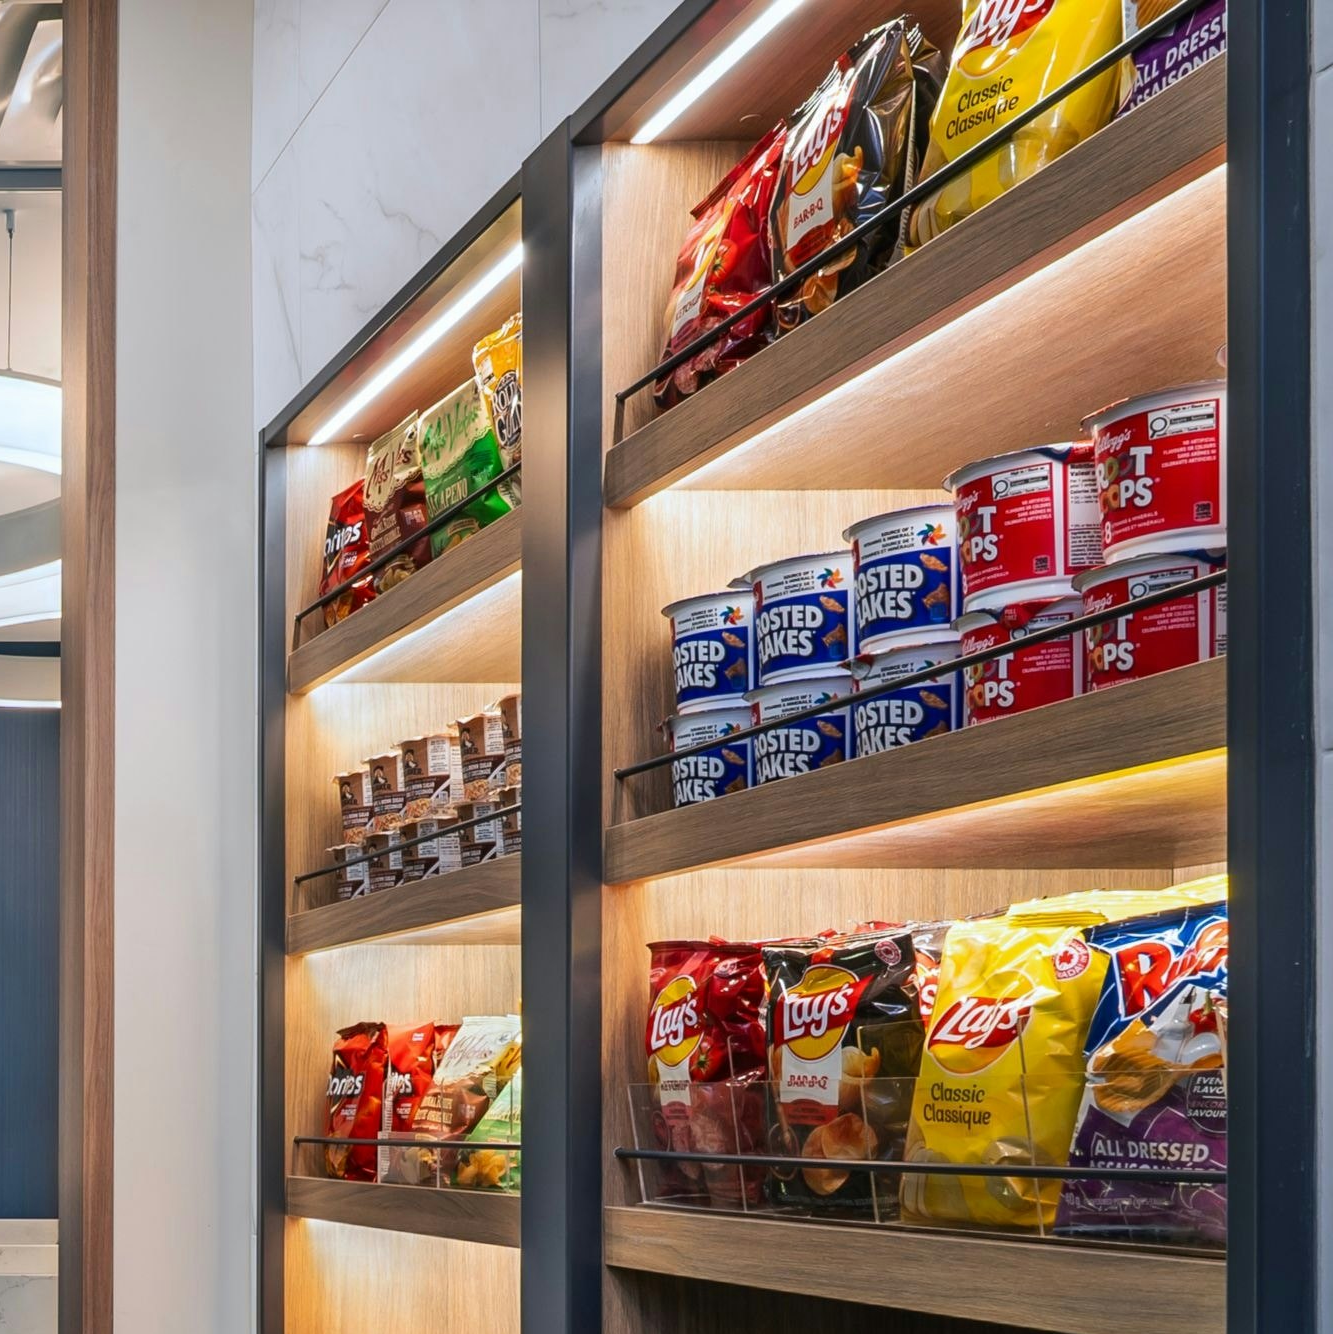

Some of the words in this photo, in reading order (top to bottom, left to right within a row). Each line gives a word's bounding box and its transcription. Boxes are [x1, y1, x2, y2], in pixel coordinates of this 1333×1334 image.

[1134, 59, 1160, 92] ALL
[1165, 11, 1227, 70] DRESS
[957, 76, 1014, 113] Classic
[946, 96, 1020, 140] Classique
[1096, 428, 1132, 454] ellogg's
[1096, 445, 1153, 491] ROOT
[1099, 477, 1154, 515] OOPS
[324, 521, 363, 552] oritos
[855, 564, 924, 599] OSTED
[756, 604, 824, 642] ROSTED
[651, 993, 698, 1051] Lay's
[783, 983, 854, 1041] Lay's
[931, 1082, 986, 1104] Classic
[1193, 1085, 1226, 1094] FLAVO
[923, 1103, 992, 1131] Classique
[1094, 1141, 1124, 1157] ALL
[1128, 1141, 1209, 1162] DRESSED
